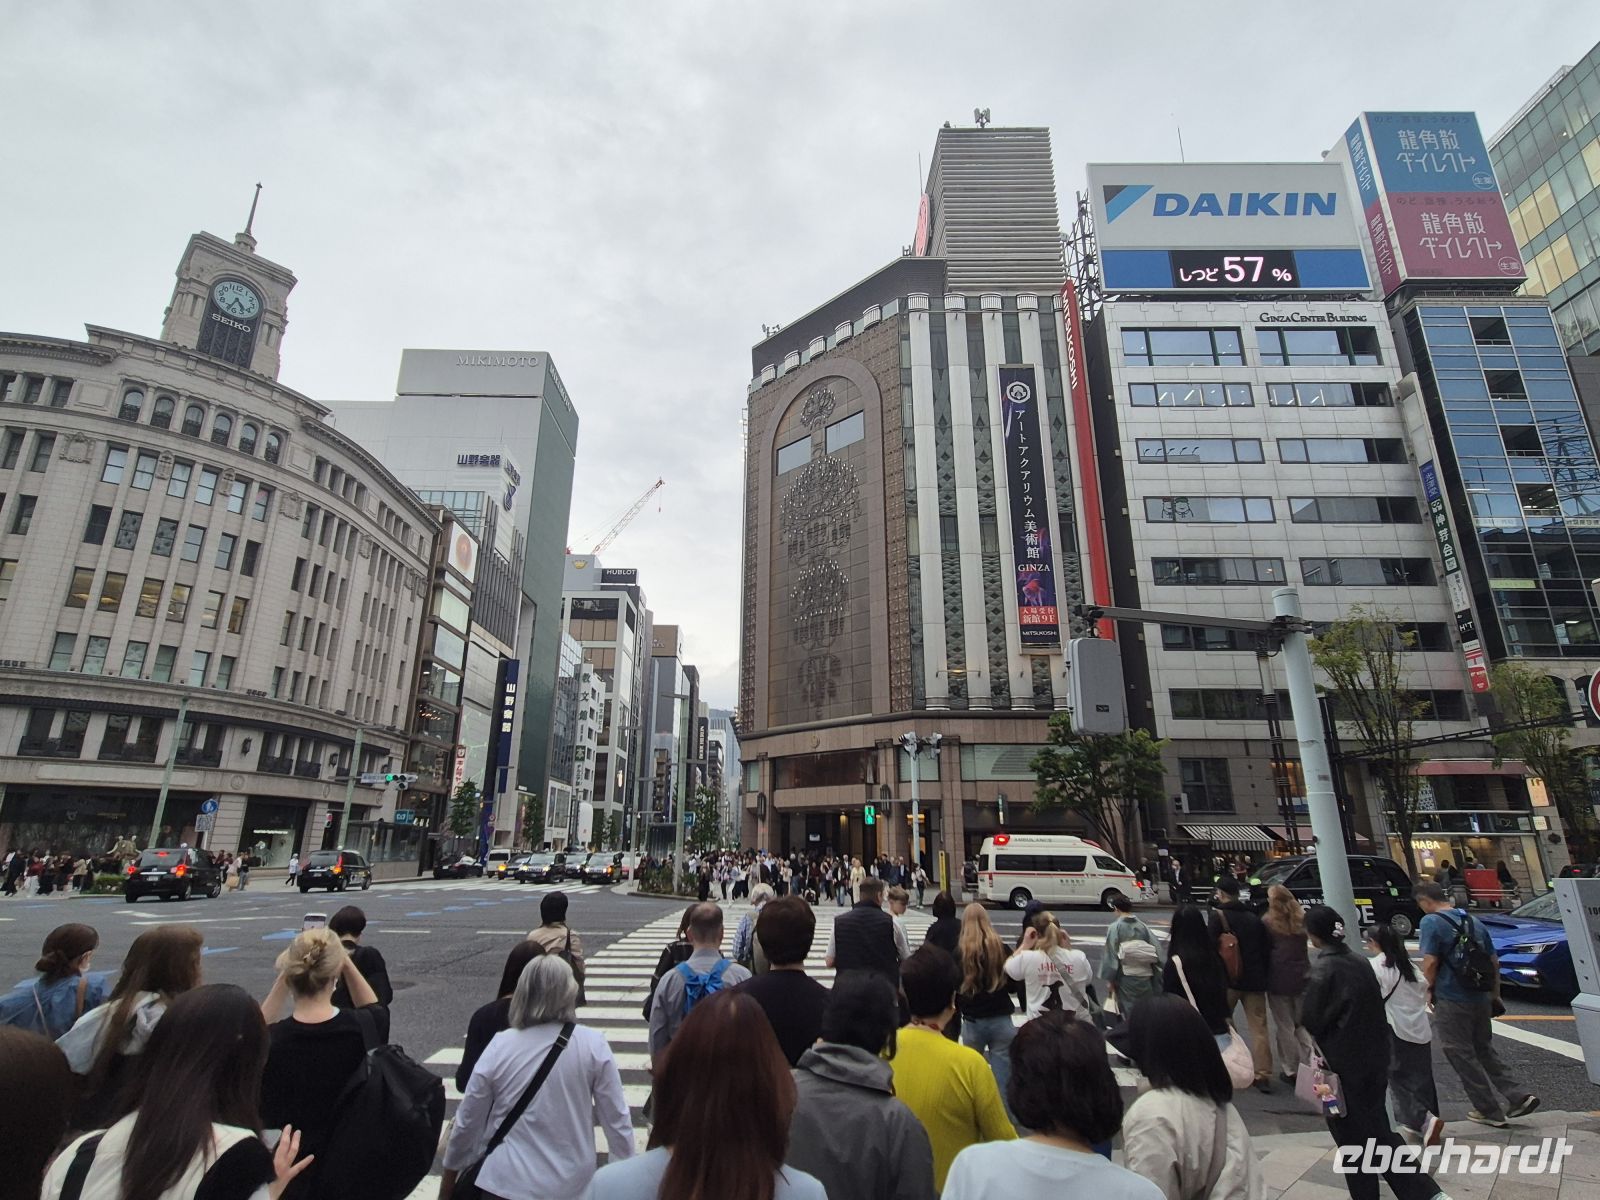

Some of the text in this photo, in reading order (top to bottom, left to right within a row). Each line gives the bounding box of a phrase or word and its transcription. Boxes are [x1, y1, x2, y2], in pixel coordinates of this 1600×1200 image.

[1398, 129, 1460, 150] 龍角散
[1396, 152, 1476, 173] ダイレクト
[1152, 192, 1337, 217] DAIKIN
[1420, 212, 1486, 234] 龍角散
[1419, 237, 1502, 259] ダイレクト
[1179, 256, 1292, 282] しつど 57 %
[211, 313, 251, 333] SEIKO
[1259, 311, 1367, 323] GINZA CENTER BUILDING
[1061, 289, 1078, 391] MITSUKOSHI
[456, 354, 539, 368] MIKIMOTO
[457, 454, 501, 466] 山野楽器
[1015, 409, 1041, 559] アートアクアリウム美術館
[1017, 563, 1051, 572] GINZA
[1411, 840, 1441, 850] HABA
